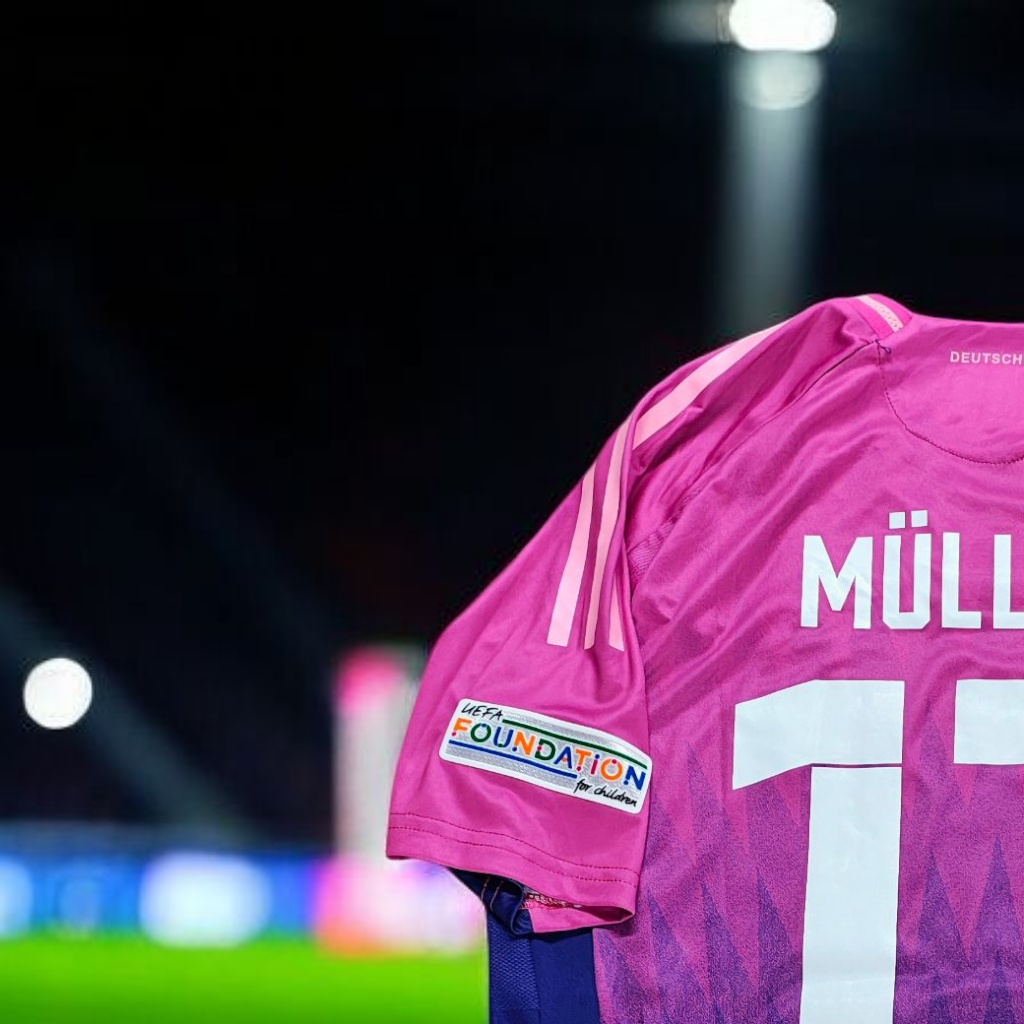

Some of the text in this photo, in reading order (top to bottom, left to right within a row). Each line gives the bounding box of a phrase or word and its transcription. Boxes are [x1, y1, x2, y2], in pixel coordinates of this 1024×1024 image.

[461, 702, 504, 721] UEFA
[573, 779, 638, 807] for children
